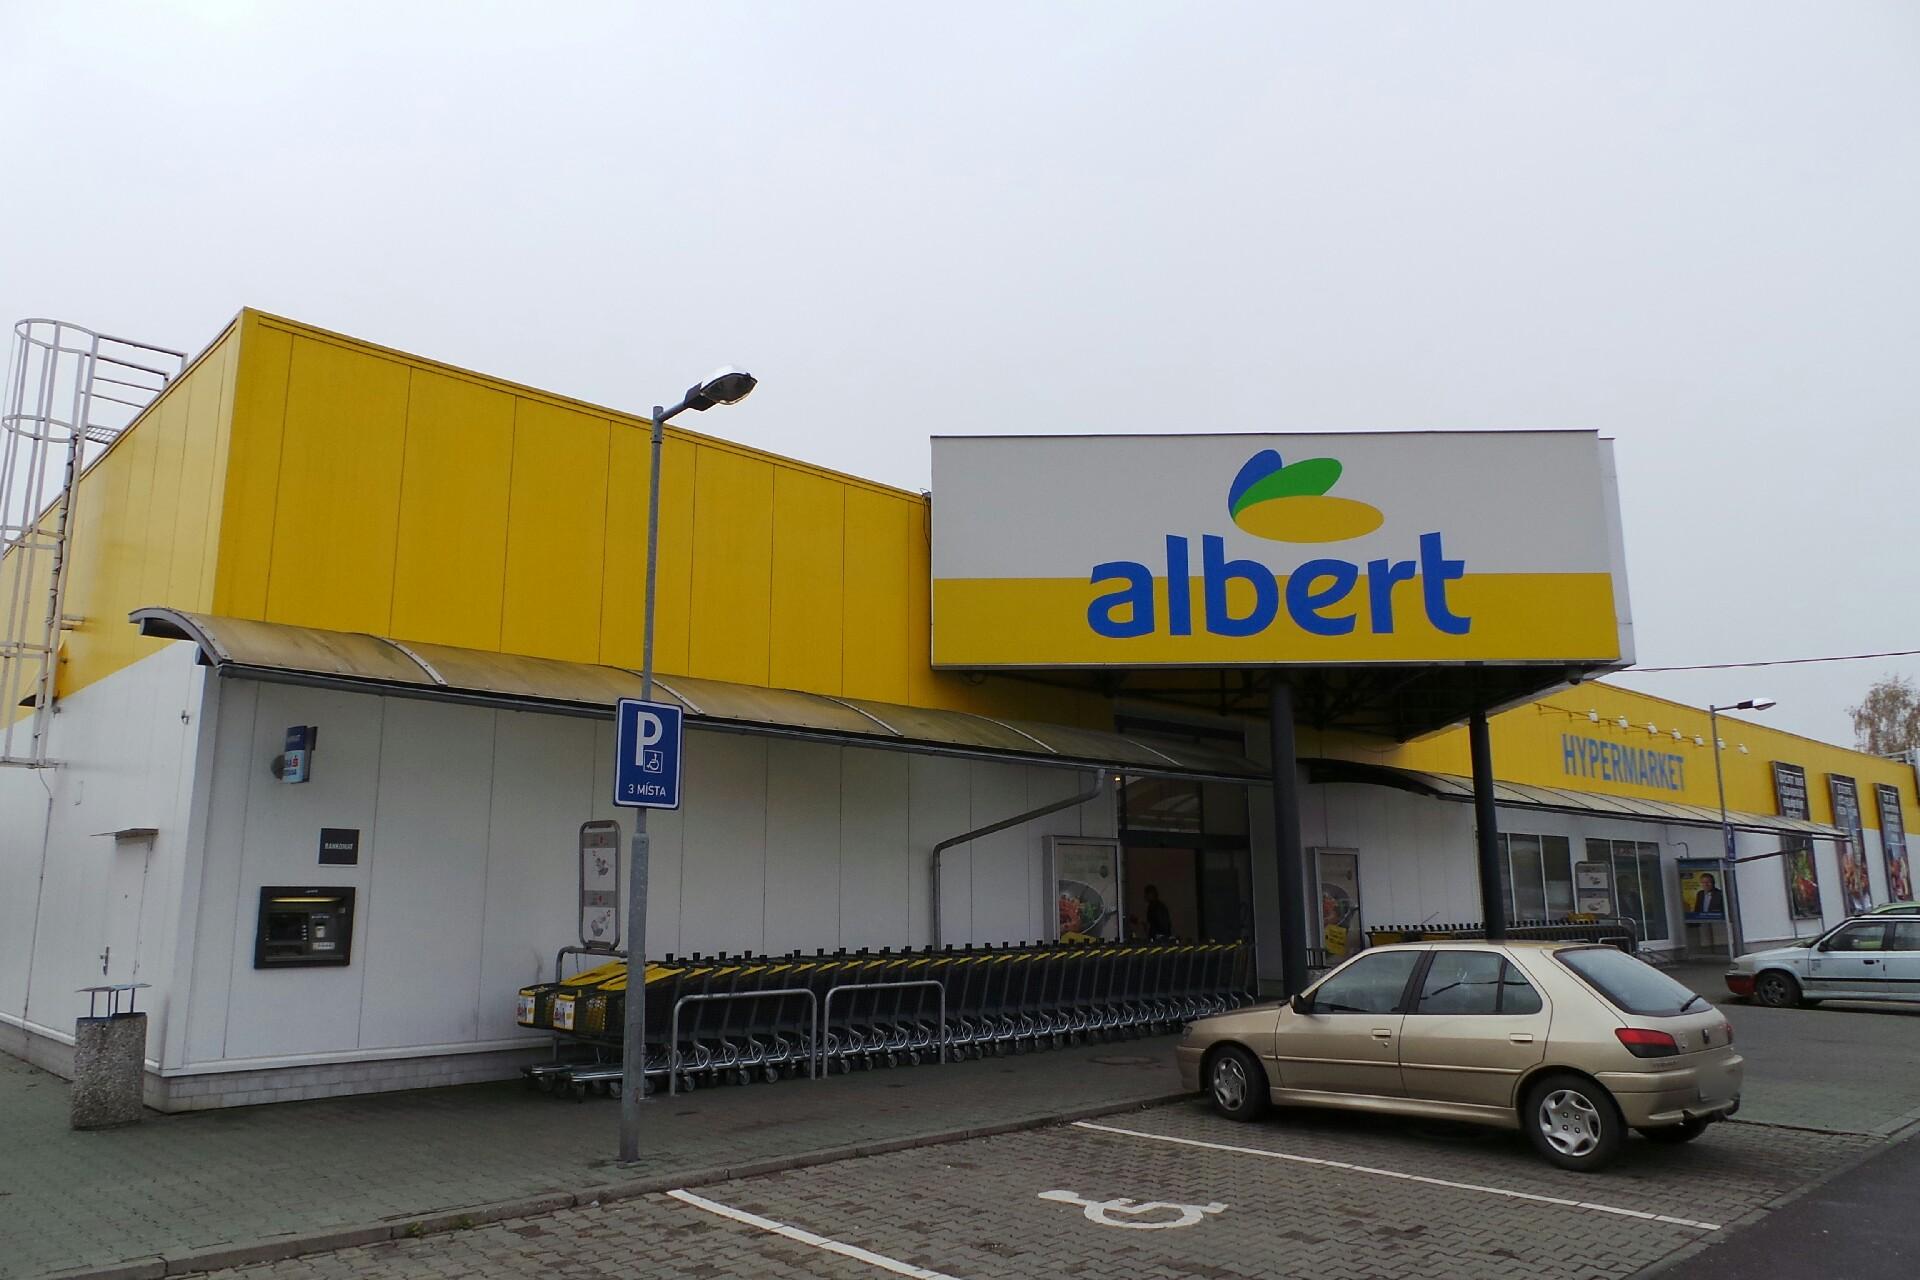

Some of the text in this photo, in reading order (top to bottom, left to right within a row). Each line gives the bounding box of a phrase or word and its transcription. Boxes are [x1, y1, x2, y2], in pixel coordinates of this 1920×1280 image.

[1087, 532, 1471, 638] albert
[635, 711, 663, 766] P
[1562, 733, 1684, 791] HYPERMARKET
[628, 782, 666, 796] 3 MÍSTA
